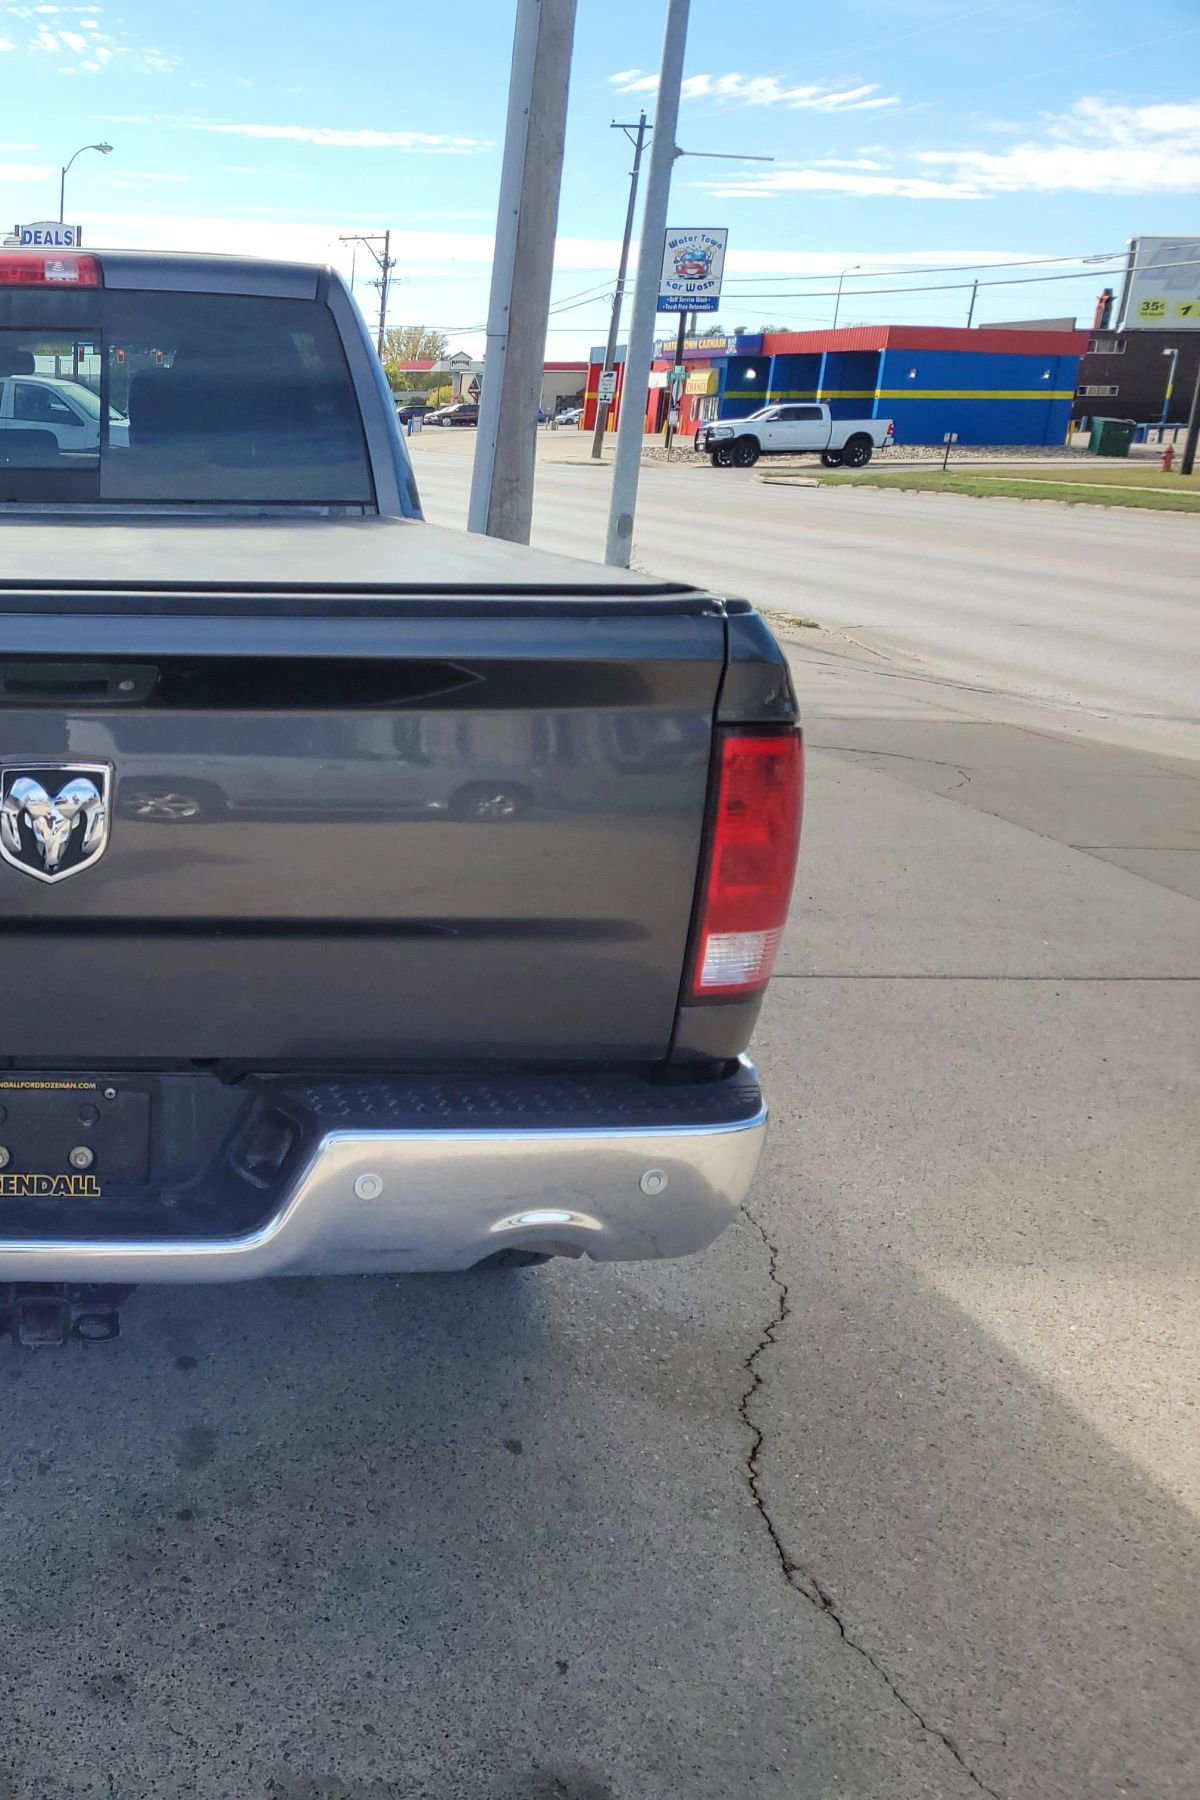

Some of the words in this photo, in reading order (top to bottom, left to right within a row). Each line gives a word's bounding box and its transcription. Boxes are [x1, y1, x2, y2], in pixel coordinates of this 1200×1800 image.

[22, 230, 73, 246] DEALS
[701, 234, 723, 250] Town
[686, 280, 715, 292] Wash
